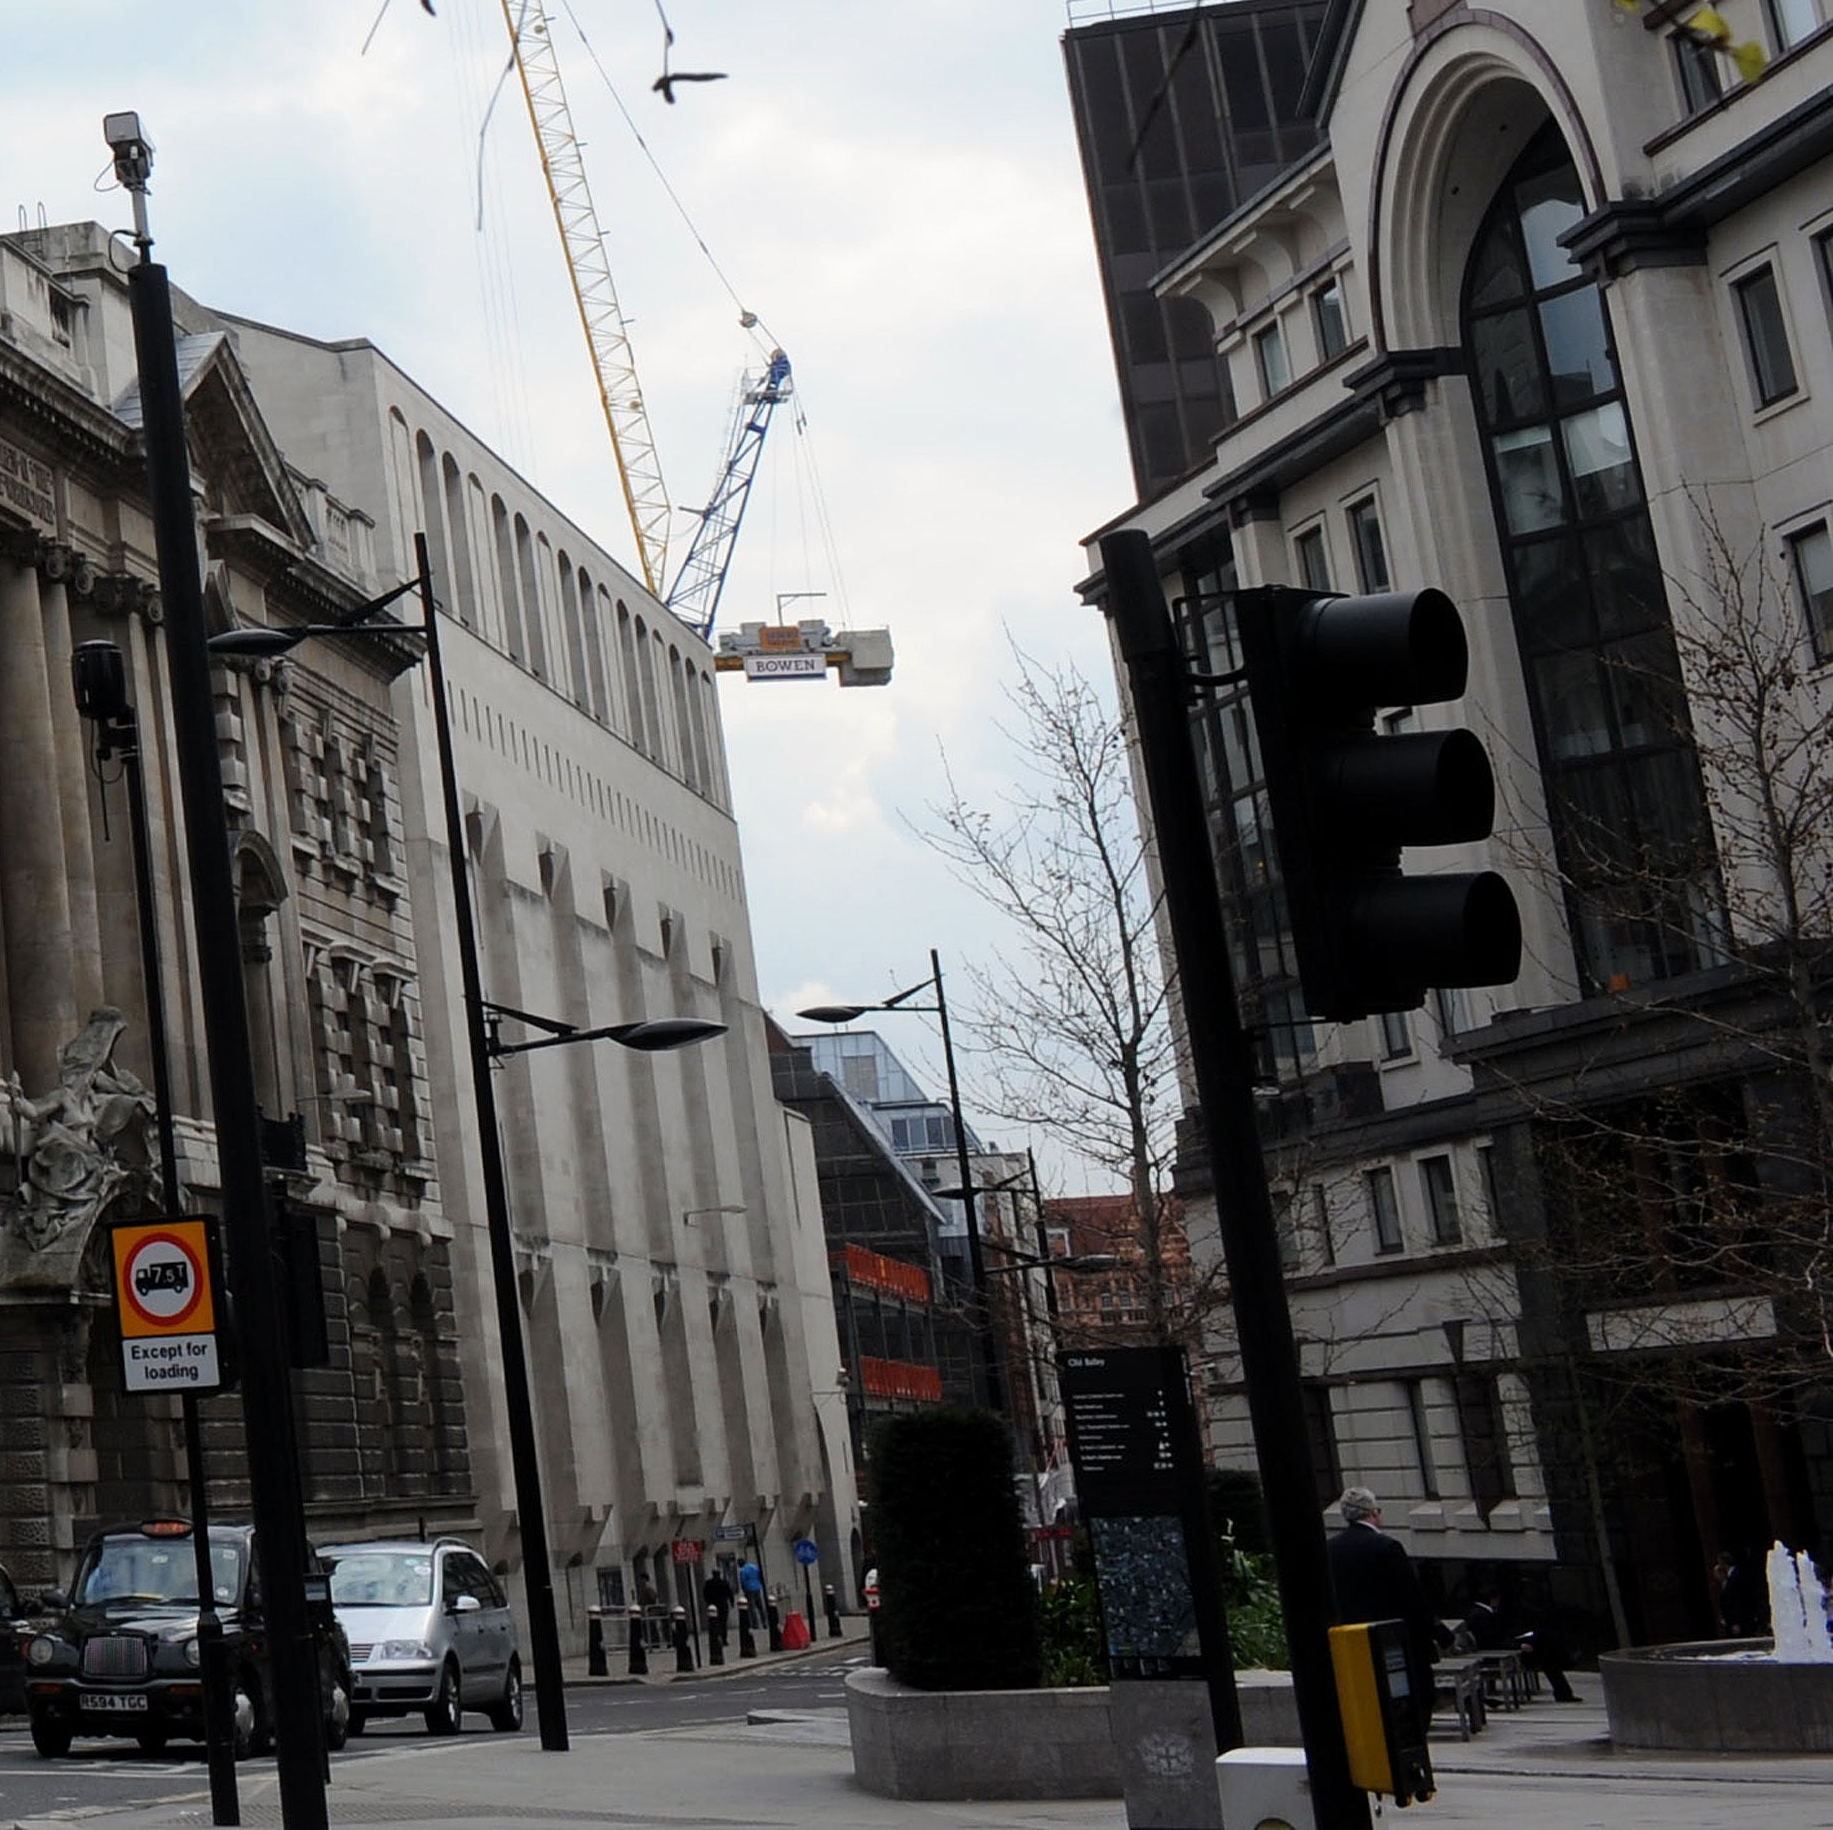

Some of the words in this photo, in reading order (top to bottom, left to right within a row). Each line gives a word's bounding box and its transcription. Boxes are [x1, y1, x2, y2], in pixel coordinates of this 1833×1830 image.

[755, 659, 816, 672] BOWEN
[130, 1343, 183, 1362] Except
[186, 1341, 209, 1357] for
[144, 1364, 200, 1381] loading
[81, 1696, 116, 1709] R594
